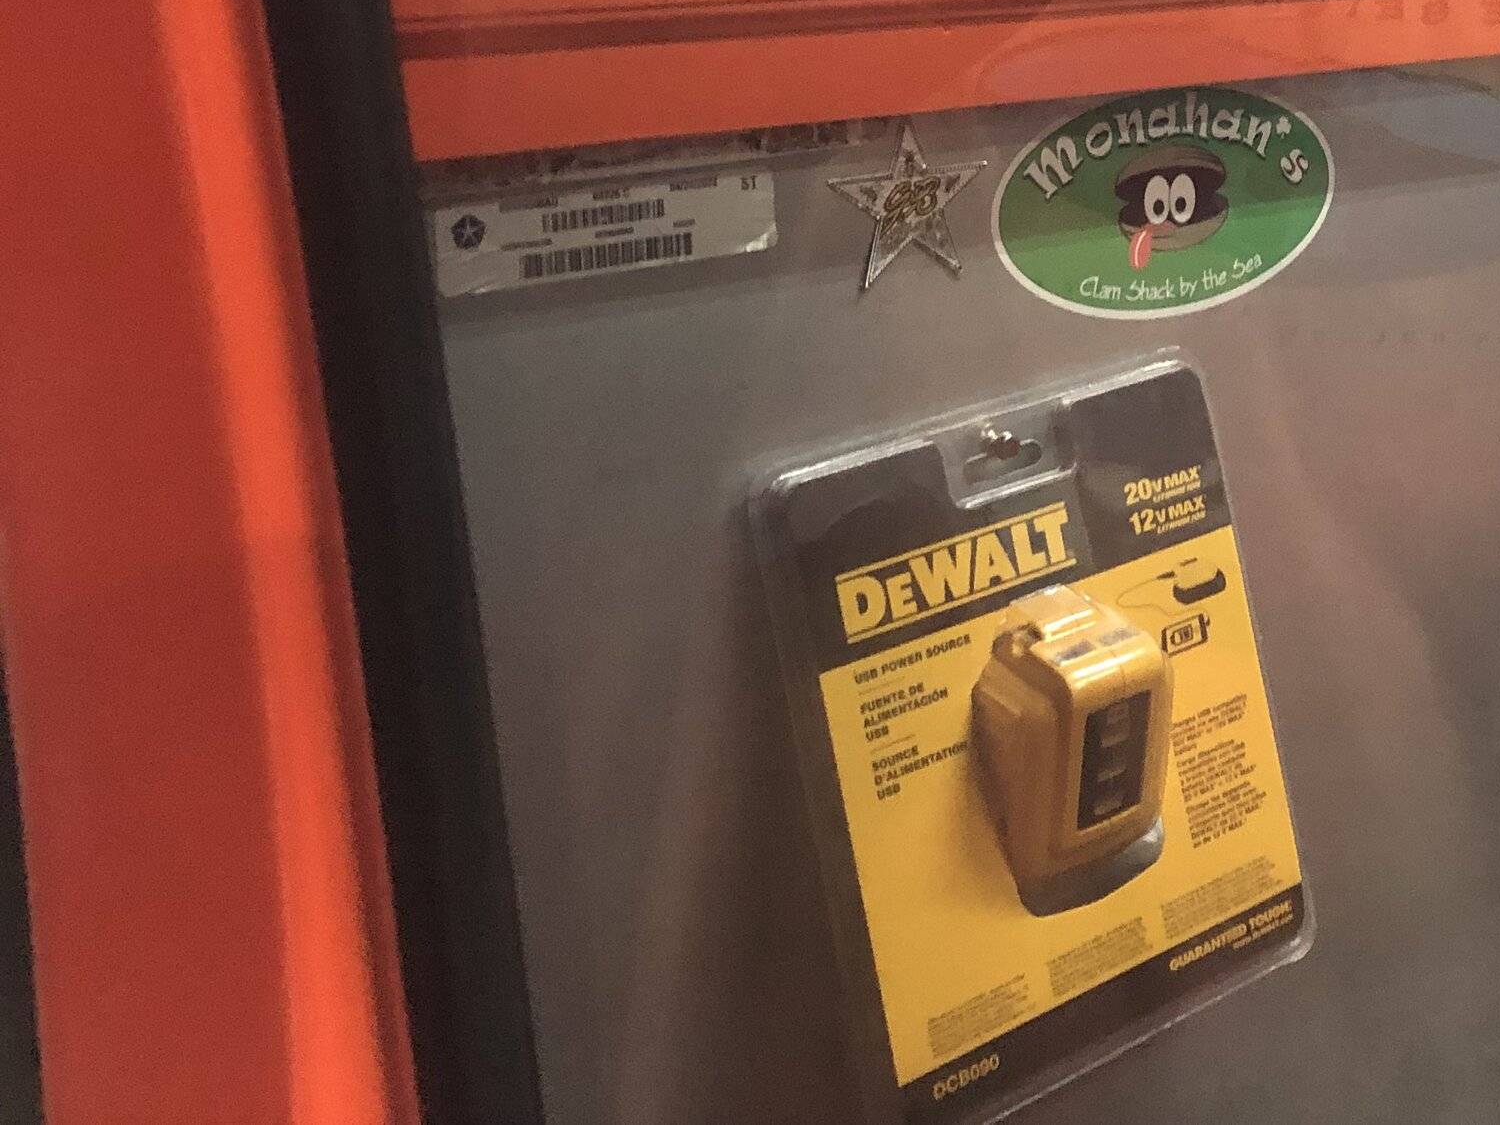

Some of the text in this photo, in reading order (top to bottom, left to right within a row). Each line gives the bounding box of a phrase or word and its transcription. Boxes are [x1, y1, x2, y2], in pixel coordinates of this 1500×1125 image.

[1079, 254, 1262, 302] Clam Shack by the Sea
[881, 652, 923, 675] POWER
[926, 634, 972, 660] SOURCE
